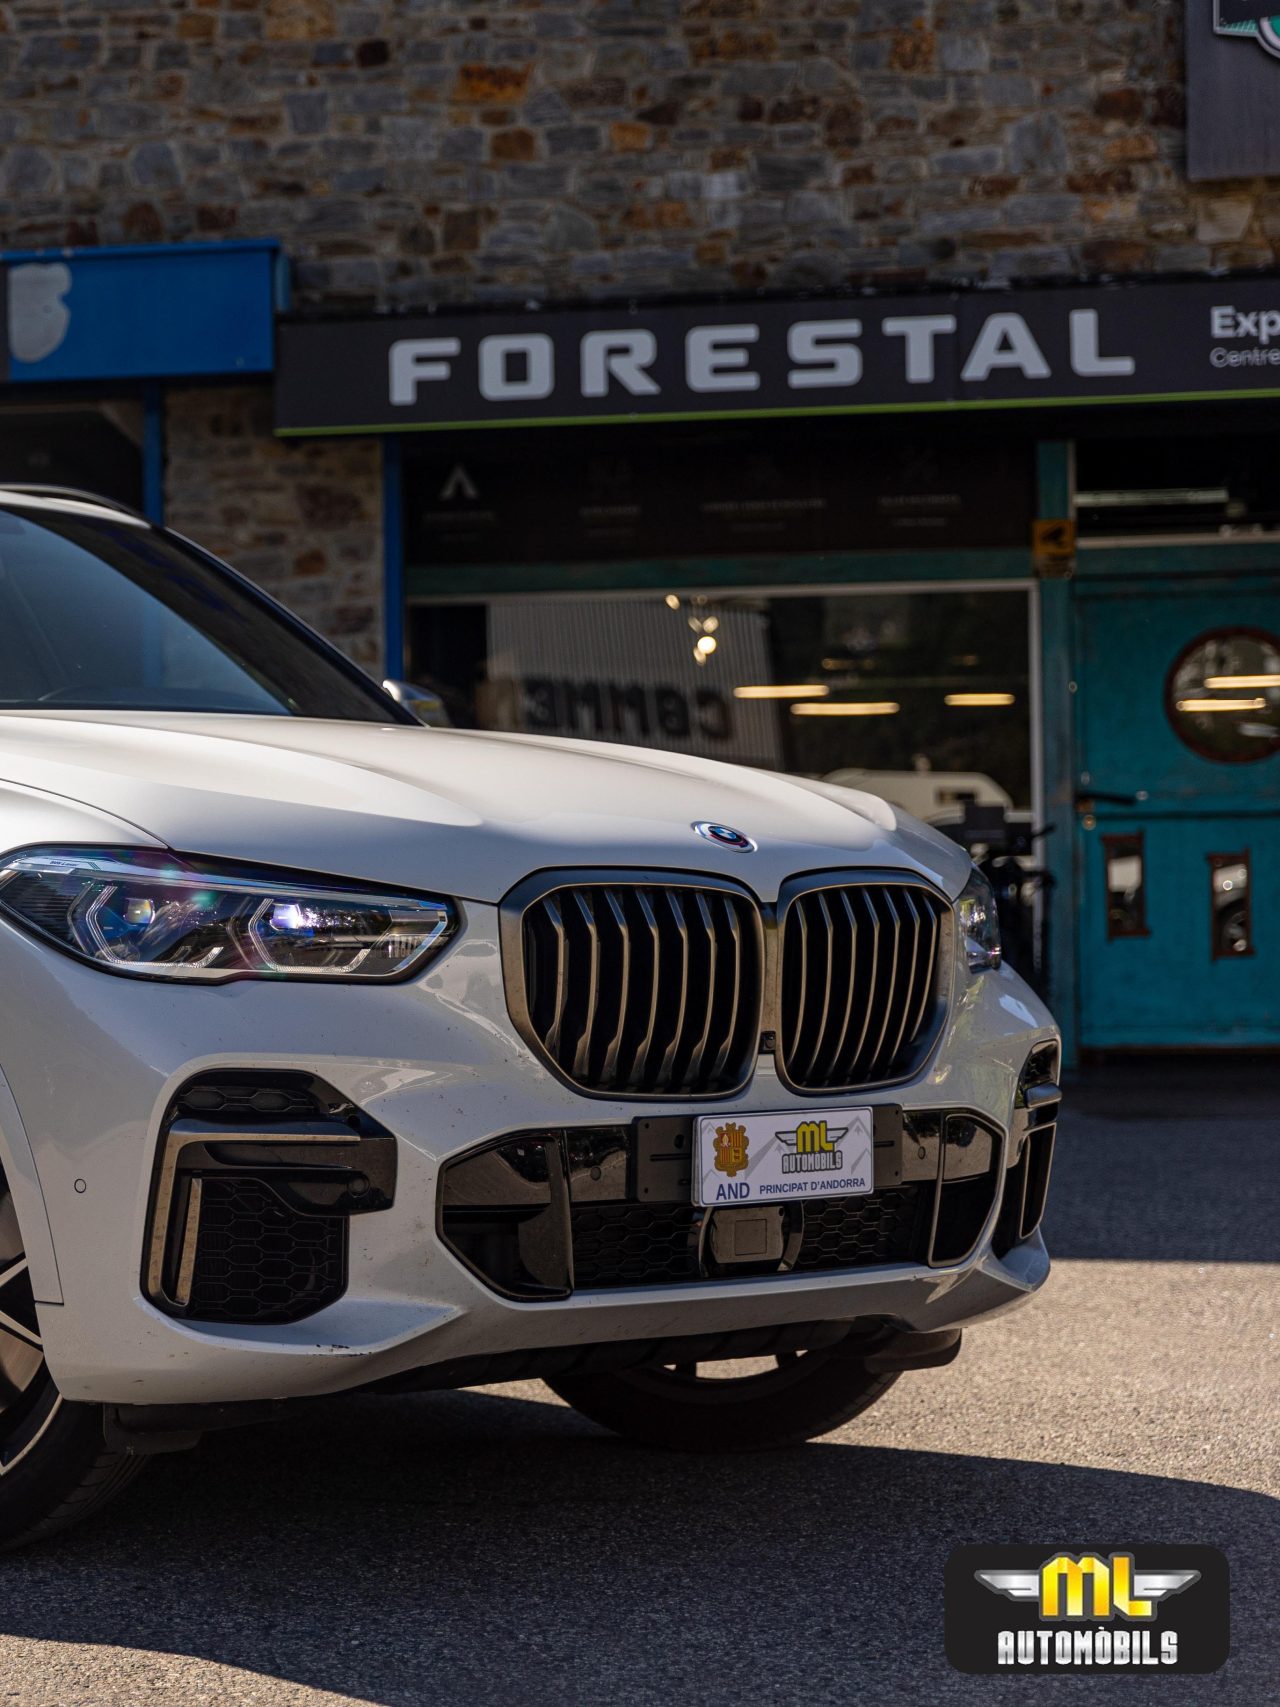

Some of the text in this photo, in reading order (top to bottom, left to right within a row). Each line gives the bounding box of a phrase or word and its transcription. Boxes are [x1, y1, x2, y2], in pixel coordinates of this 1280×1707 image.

[388, 308, 1136, 406] FORESTAL
[1209, 346, 1280, 368] Centre
[796, 1120, 834, 1153] ML
[782, 1151, 843, 1174] AUTOMOBILS
[716, 1178, 866, 1201] AND PRINCIPAT D'ANDORRA
